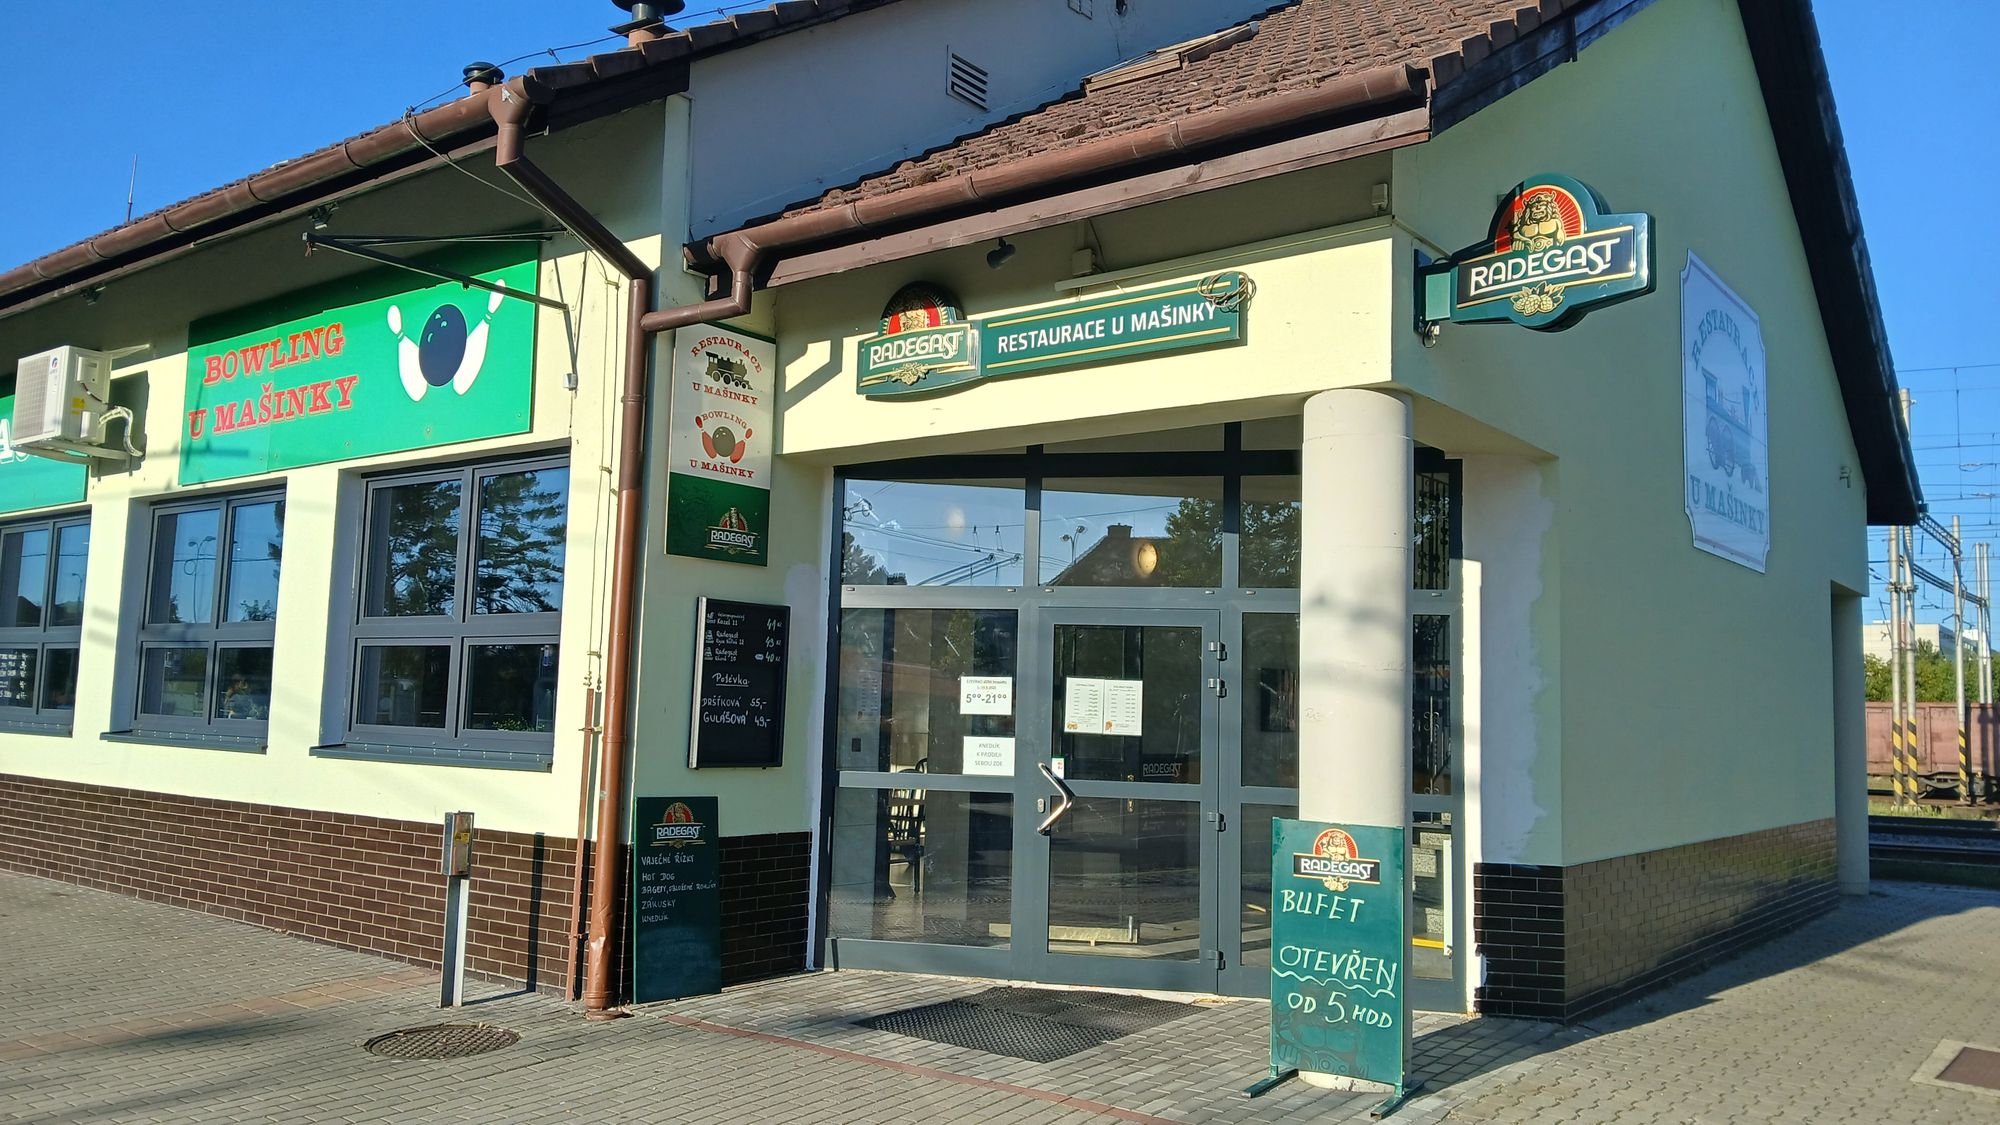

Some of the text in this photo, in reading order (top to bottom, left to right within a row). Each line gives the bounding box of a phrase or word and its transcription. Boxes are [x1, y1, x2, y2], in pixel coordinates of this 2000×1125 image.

[1470, 237, 1621, 298] RADEGAST
[998, 302, 1216, 354] RESTAURACE U MAŠINKY
[203, 322, 345, 386] BOWLING
[690, 336, 762, 374] RESTAURACE
[869, 330, 963, 370] RADEGAST
[1692, 309, 1760, 412] RESTAURACE
[188, 375, 358, 440] U MAŠINKY
[692, 382, 758, 405] U MAŠINKY
[701, 411, 747, 429] BOWLING
[690, 459, 754, 478] U MAŠINKY
[1689, 474, 1765, 535] U MAŠINKY
[711, 530, 755, 548] RADEGAST
[1143, 763, 1182, 778] RADEGAST
[656, 826, 701, 839] RADEGAST
[642, 872, 675, 881] HOT DOG
[1300, 858, 1375, 880] RADEGAST
[1281, 889, 1365, 923] BUFET
[1280, 945, 1398, 991] OTEVŘEN
[1287, 992, 1317, 1014] OD
